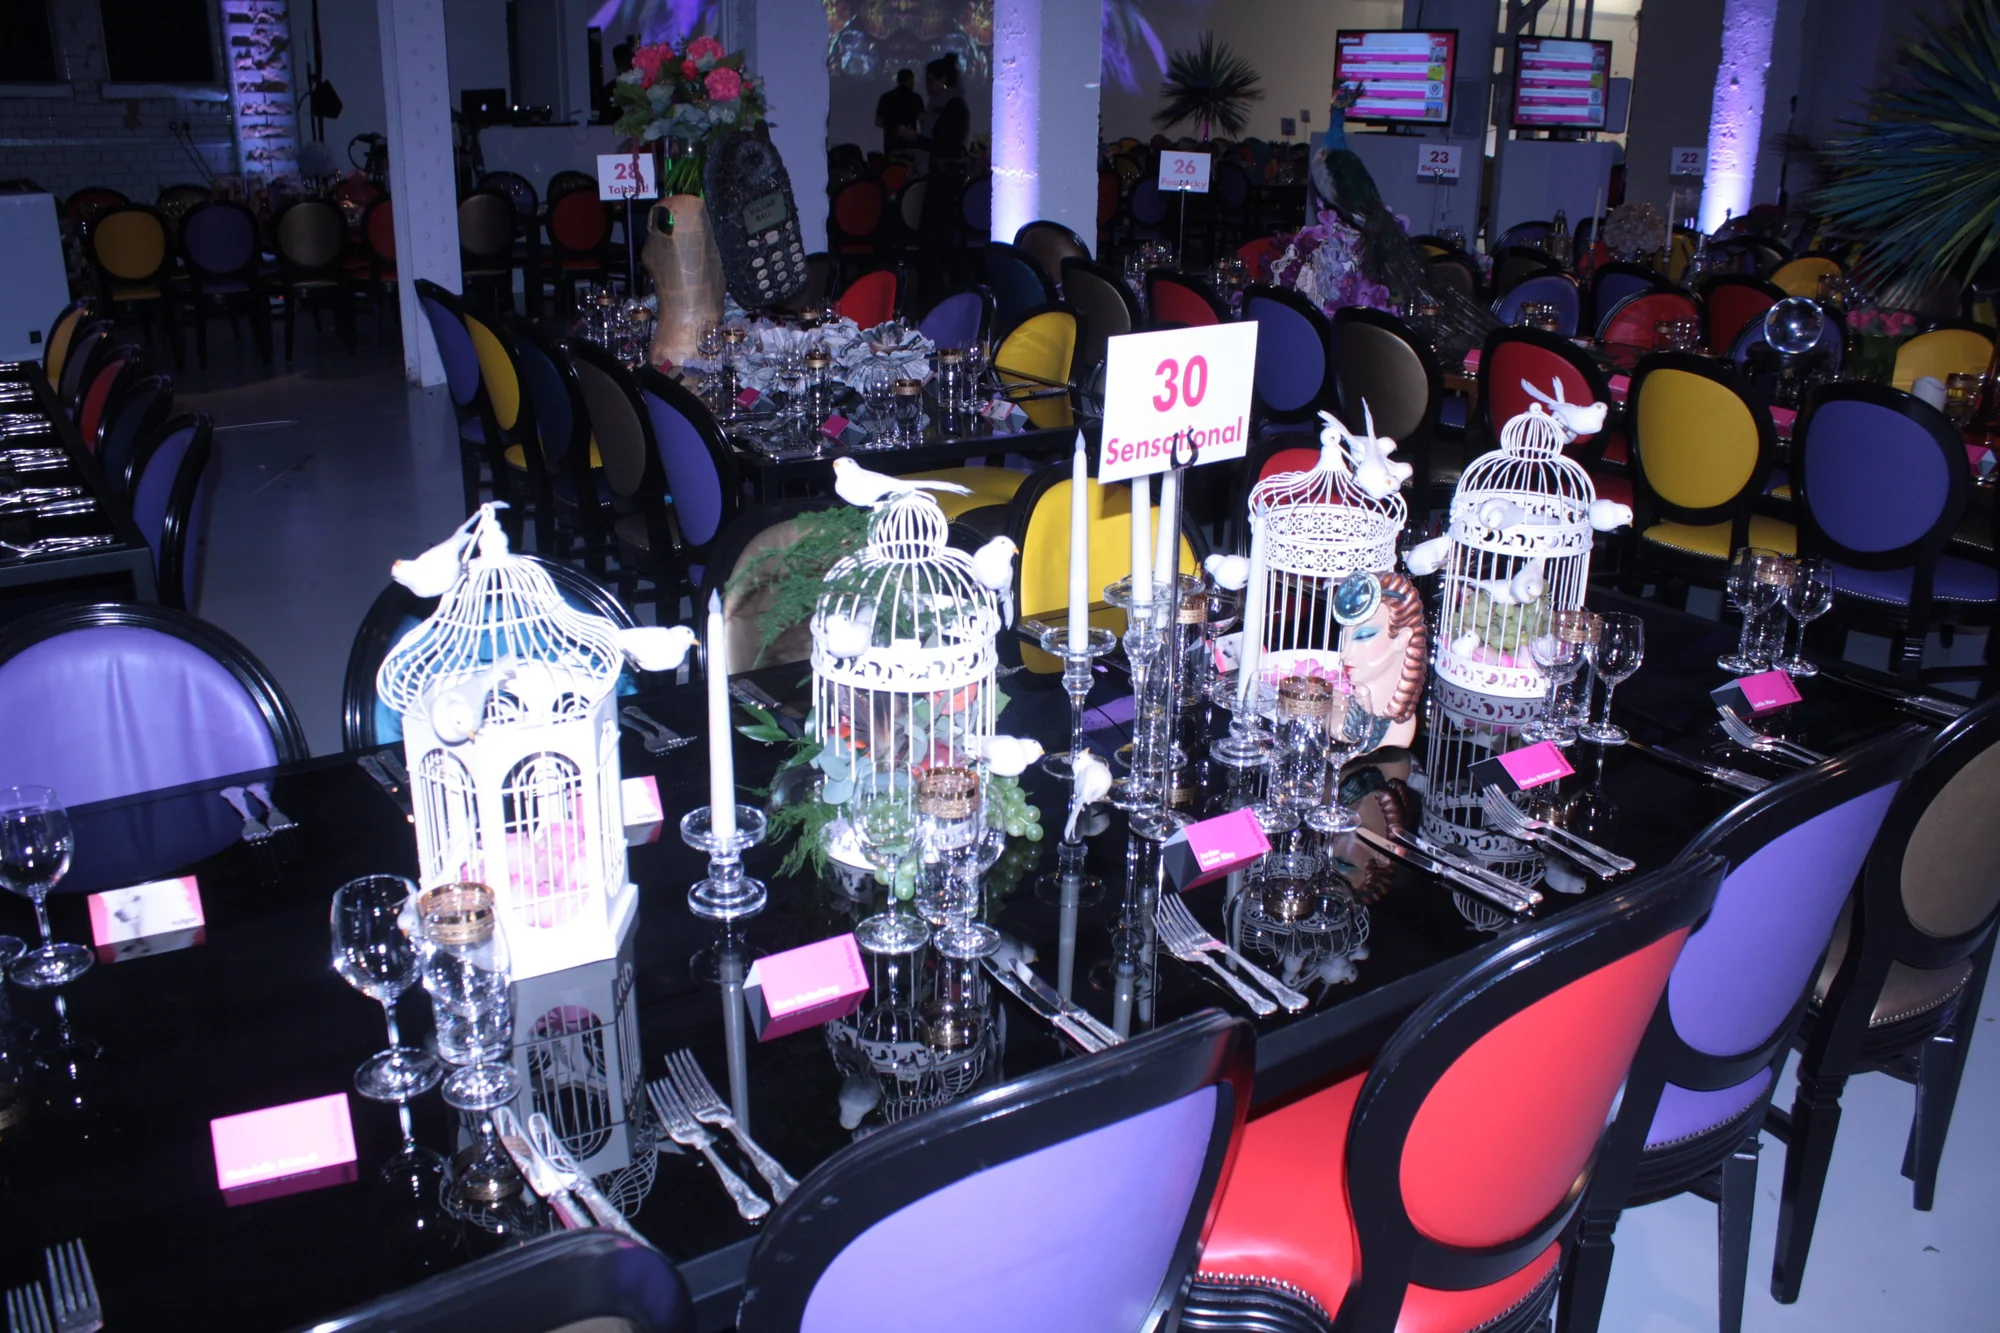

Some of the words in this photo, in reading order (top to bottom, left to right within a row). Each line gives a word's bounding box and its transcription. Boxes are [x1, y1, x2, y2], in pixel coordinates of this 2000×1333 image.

[1430, 150, 1449, 164] 23
[1681, 152, 1698, 164] 22
[1174, 159, 1197, 175] 26
[1152, 354, 1208, 413] 30
